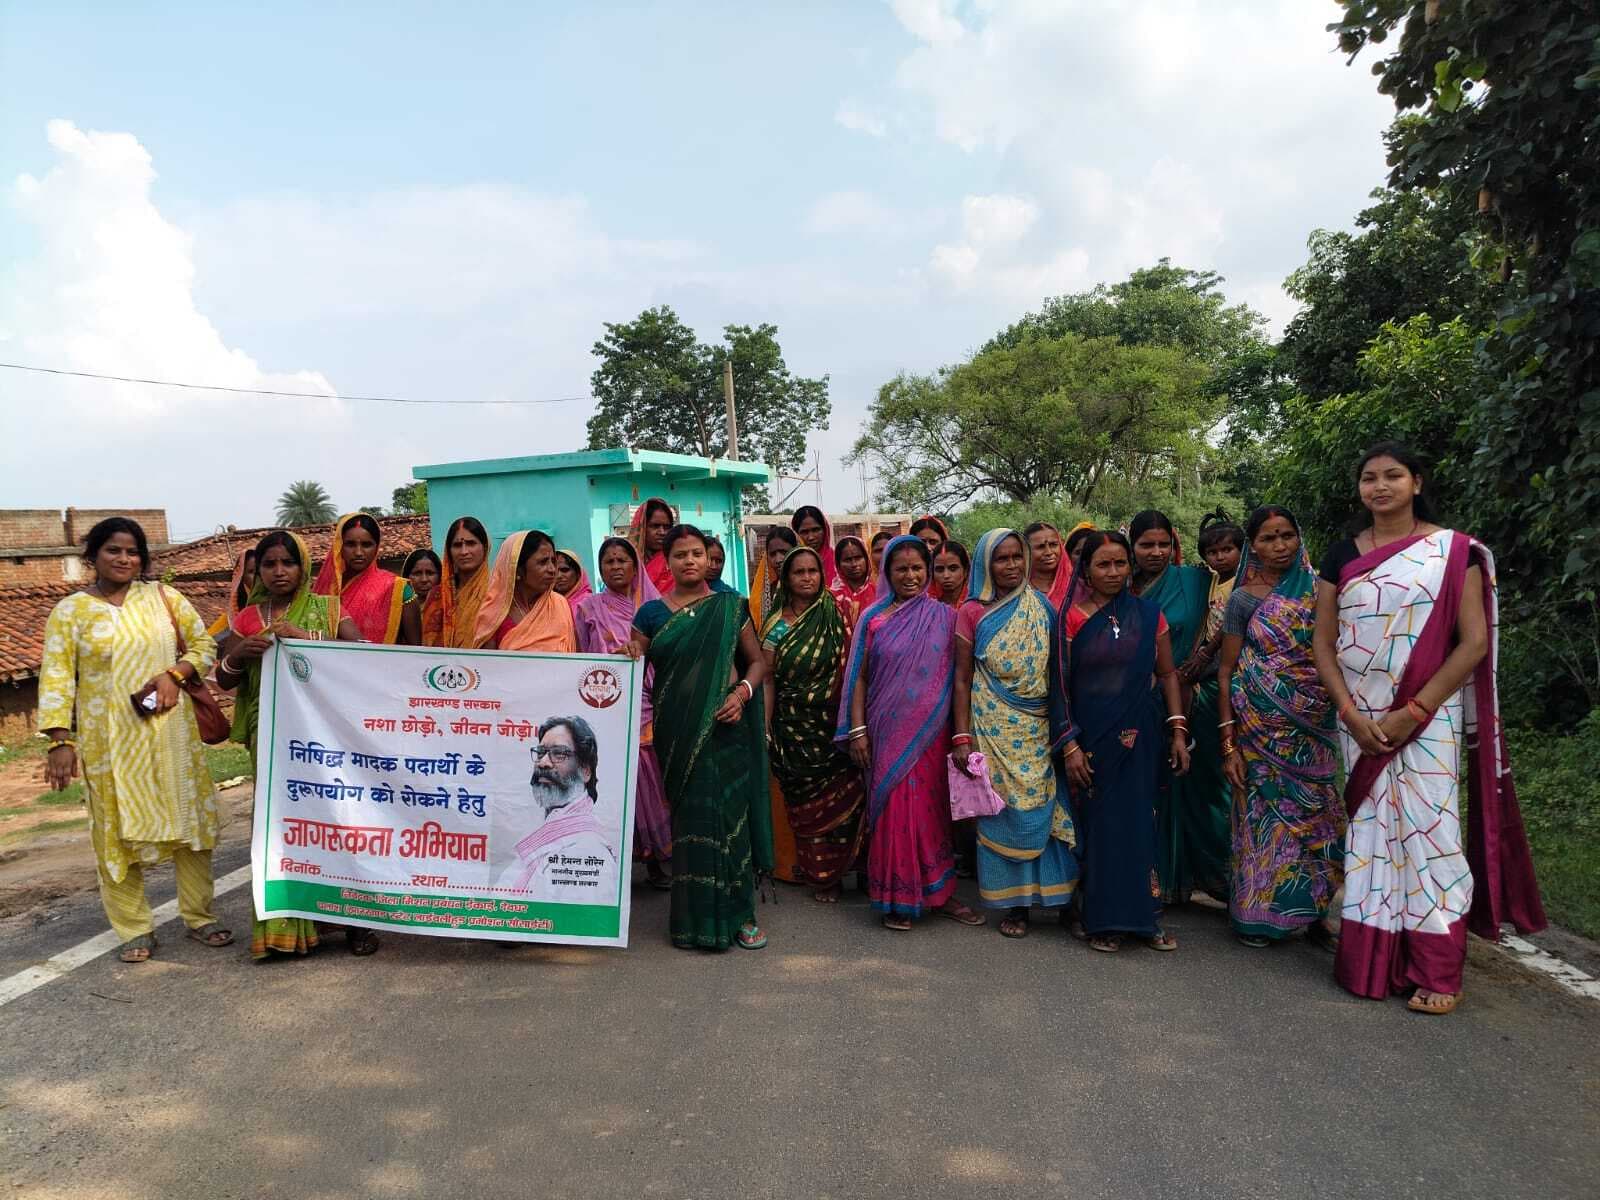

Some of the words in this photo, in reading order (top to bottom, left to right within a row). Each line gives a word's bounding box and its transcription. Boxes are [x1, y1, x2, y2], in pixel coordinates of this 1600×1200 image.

[463, 700, 502, 712] सरकार
[364, 717, 396, 732] नशा
[450, 717, 492, 736] जीवन
[289, 740, 345, 768] निषिद्ध
[351, 752, 398, 772] मादक
[465, 754, 486, 775] के
[287, 778, 364, 802] दुरूपयोग
[371, 783, 394, 803] को
[400, 785, 451, 809] रोकने
[457, 788, 486, 817] हेतु
[283, 818, 394, 857] जागरूकता
[399, 821, 488, 862] अभियान
[548, 854, 559, 864] श्री
